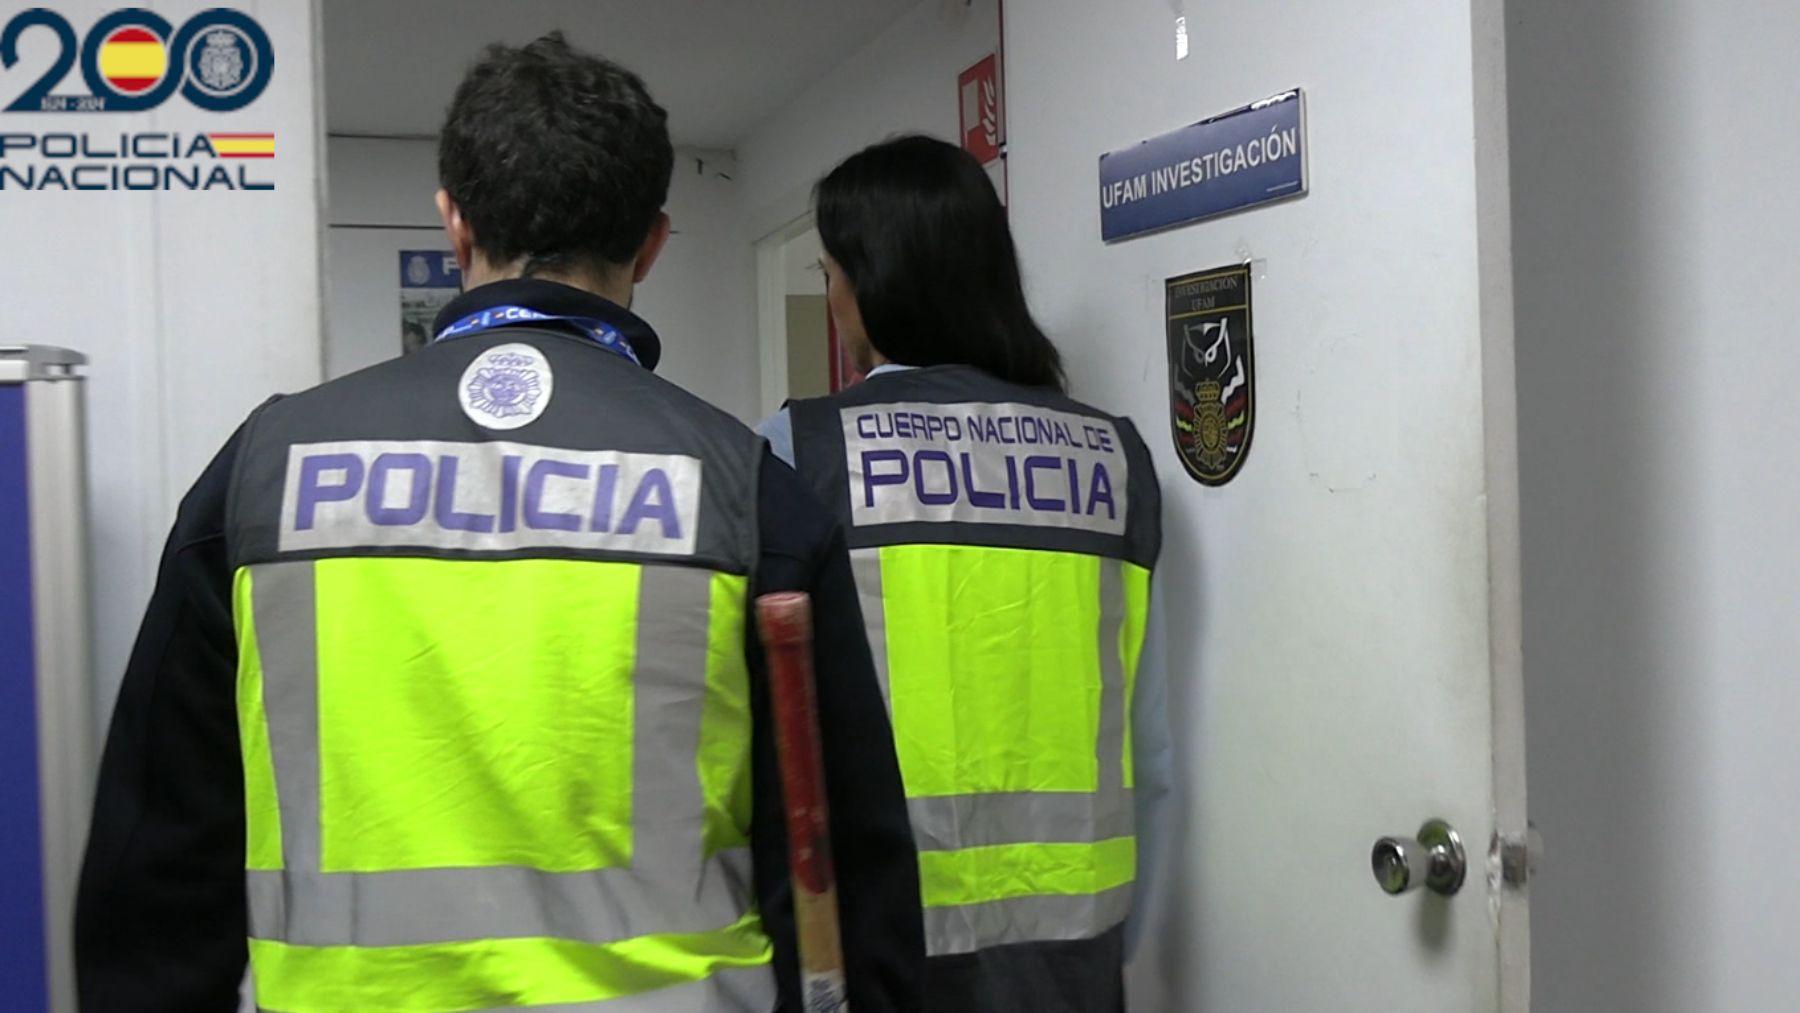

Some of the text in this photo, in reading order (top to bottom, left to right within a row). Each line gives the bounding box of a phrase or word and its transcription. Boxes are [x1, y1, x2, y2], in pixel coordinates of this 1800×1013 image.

[1102, 124, 1297, 209] UFAM INVESTIGACIÓN
[856, 412, 1115, 453] CUERPO NACIONAL DE
[294, 452, 683, 540] POLICIA
[861, 449, 1116, 520] POLICIA
